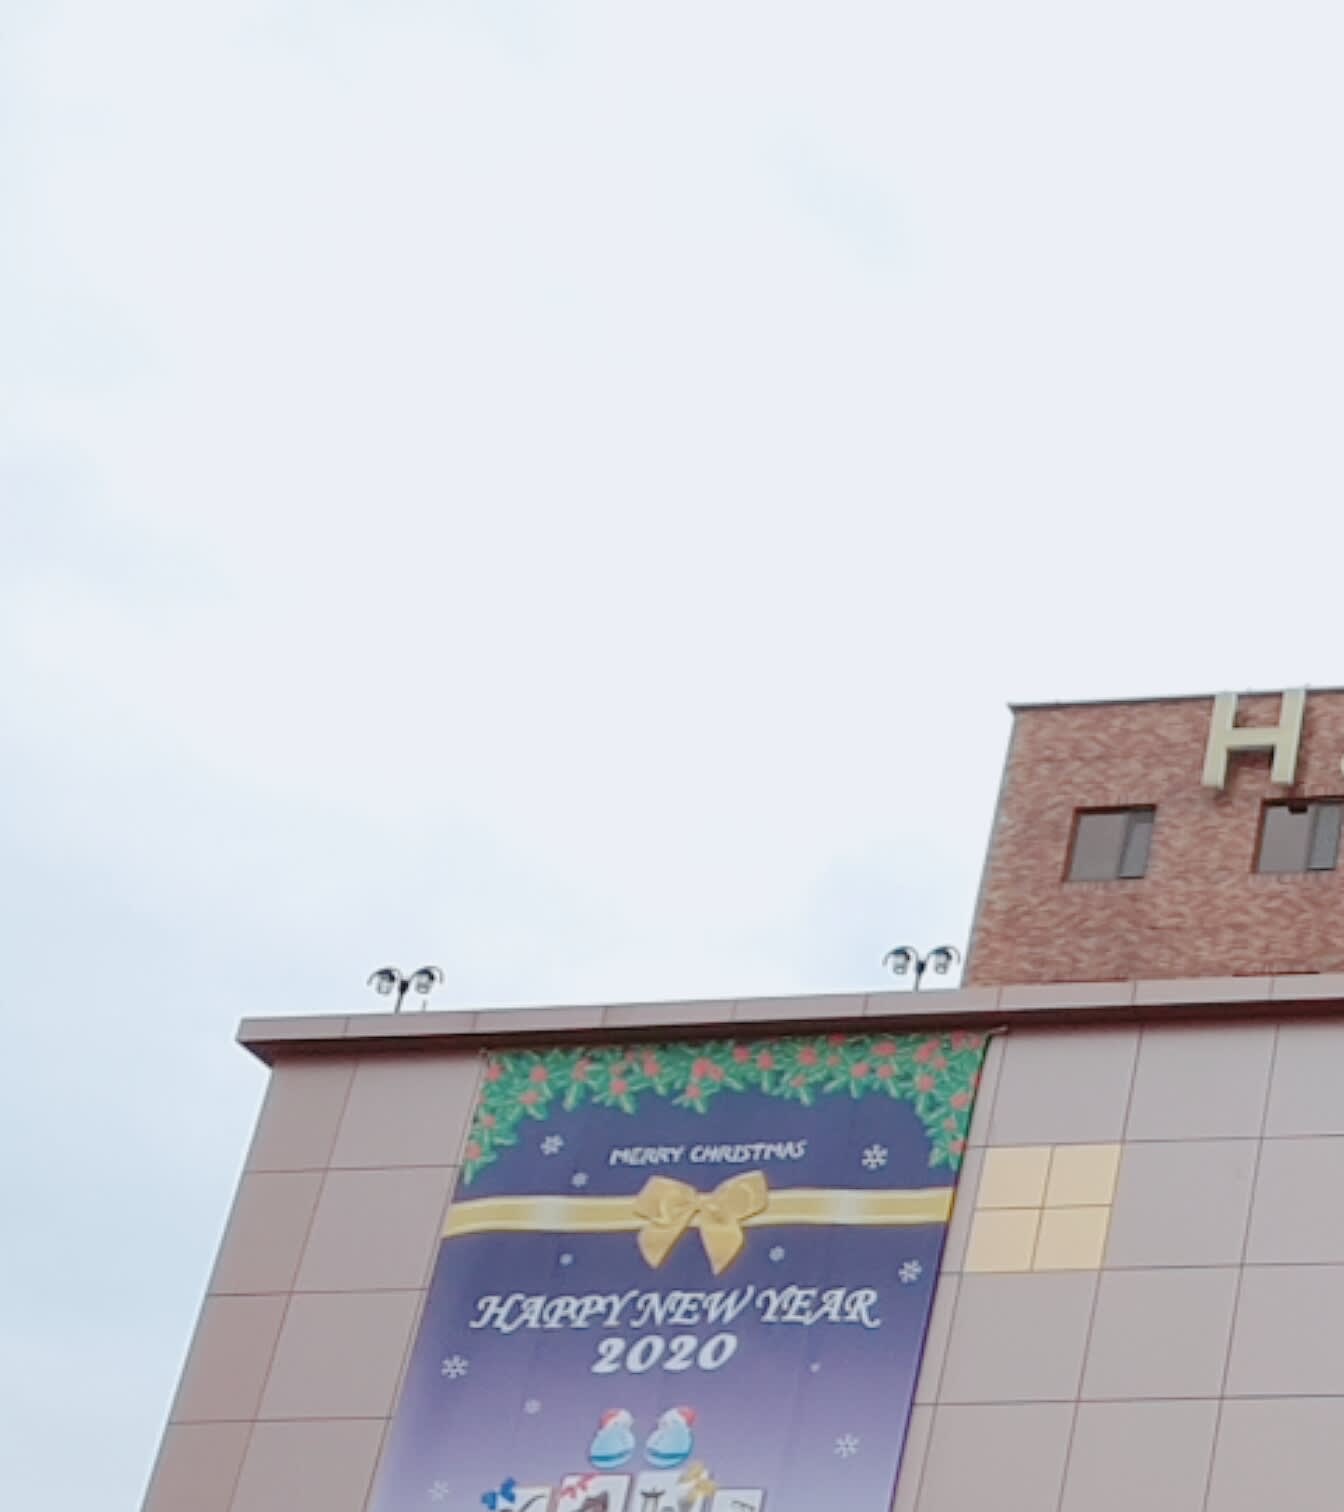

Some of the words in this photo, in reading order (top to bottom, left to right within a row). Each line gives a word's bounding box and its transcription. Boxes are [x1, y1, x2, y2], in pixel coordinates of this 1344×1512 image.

[609, 1145, 684, 1166] MERRY
[690, 1139, 808, 1164] CHRISTMAS
[469, 1289, 640, 1334] HAPPY
[630, 1285, 756, 1329] NEW
[756, 1284, 882, 1329] YEAR
[591, 1332, 738, 1374] 2020
